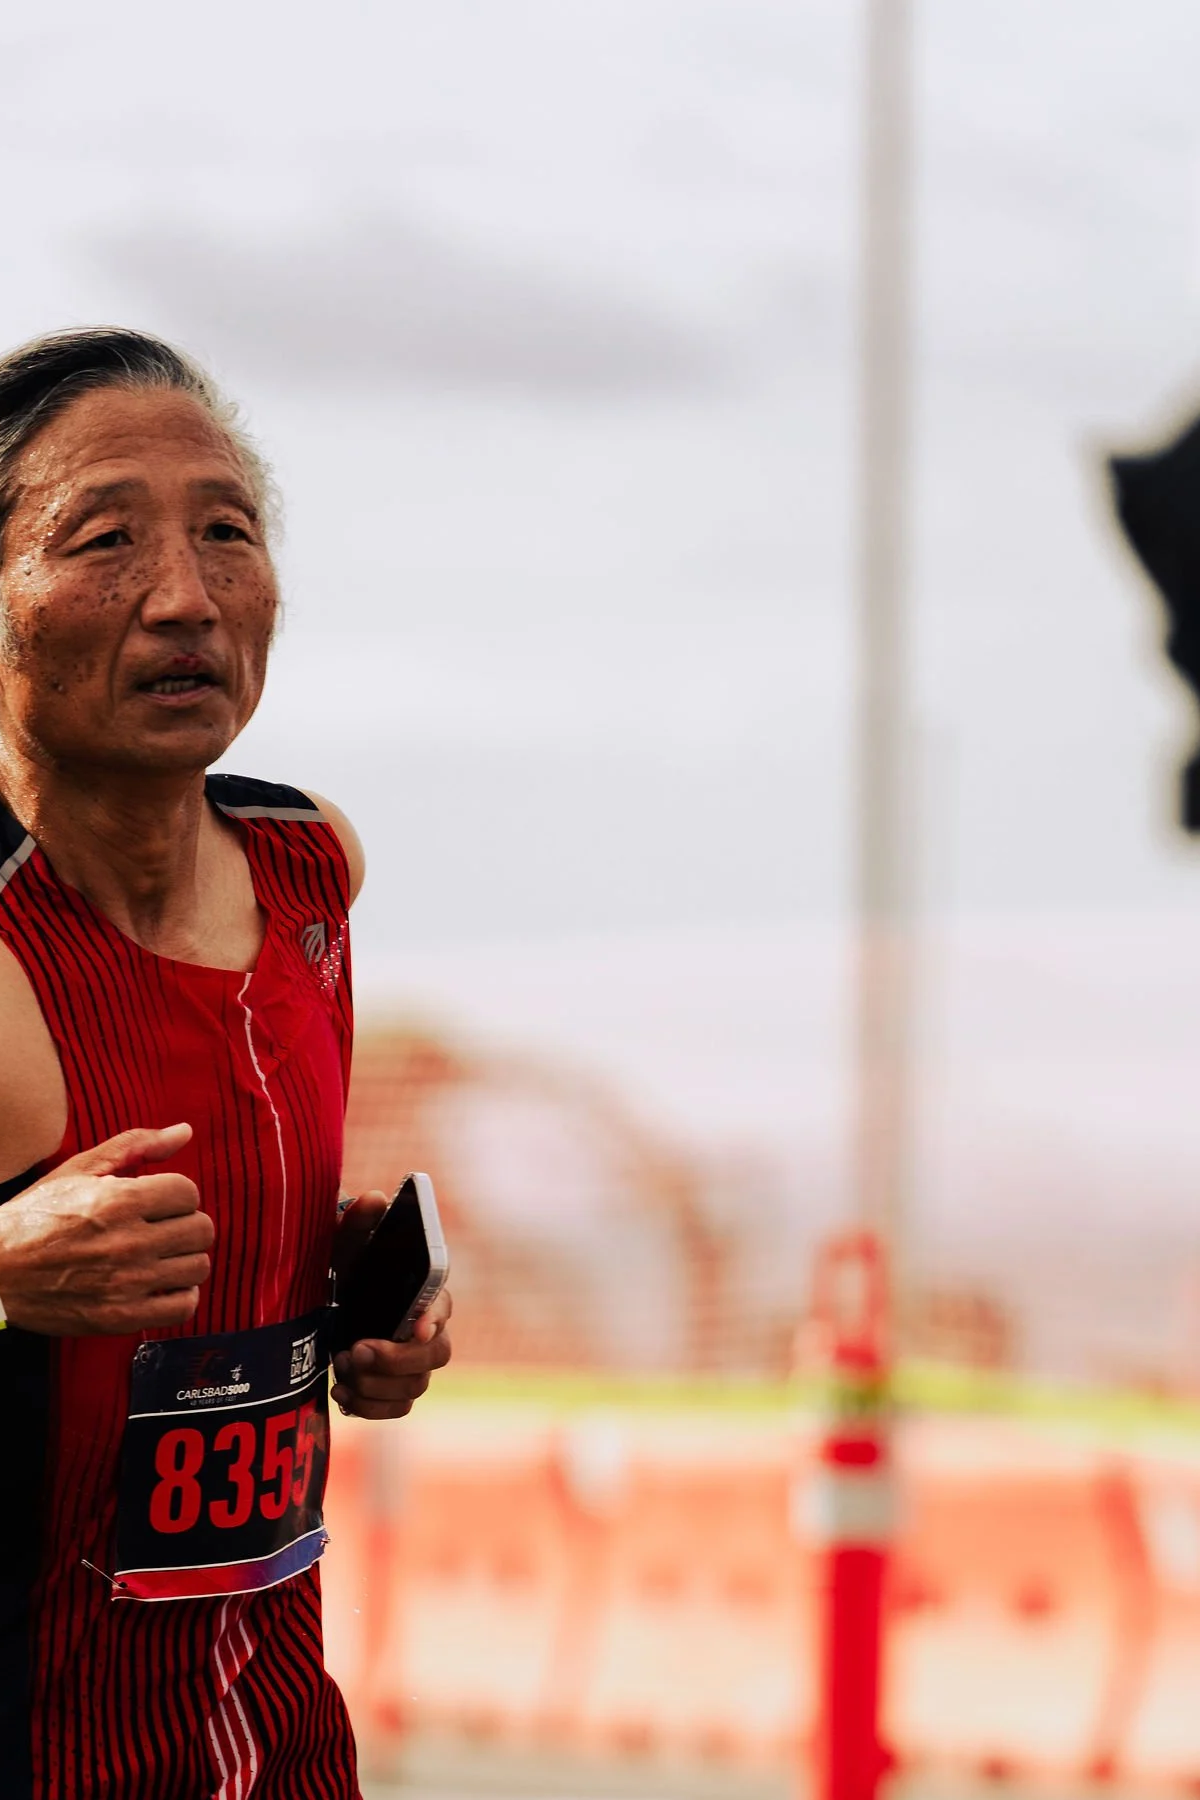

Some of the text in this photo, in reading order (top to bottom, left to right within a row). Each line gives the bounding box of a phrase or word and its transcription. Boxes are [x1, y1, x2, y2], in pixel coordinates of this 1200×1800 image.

[291, 1346, 303, 1362] ALL
[302, 1339, 316, 1373] 20
[290, 1361, 302, 1377] DAY
[176, 1382, 249, 1401] CARLSBAD5000
[149, 1397, 317, 1534] 8355
